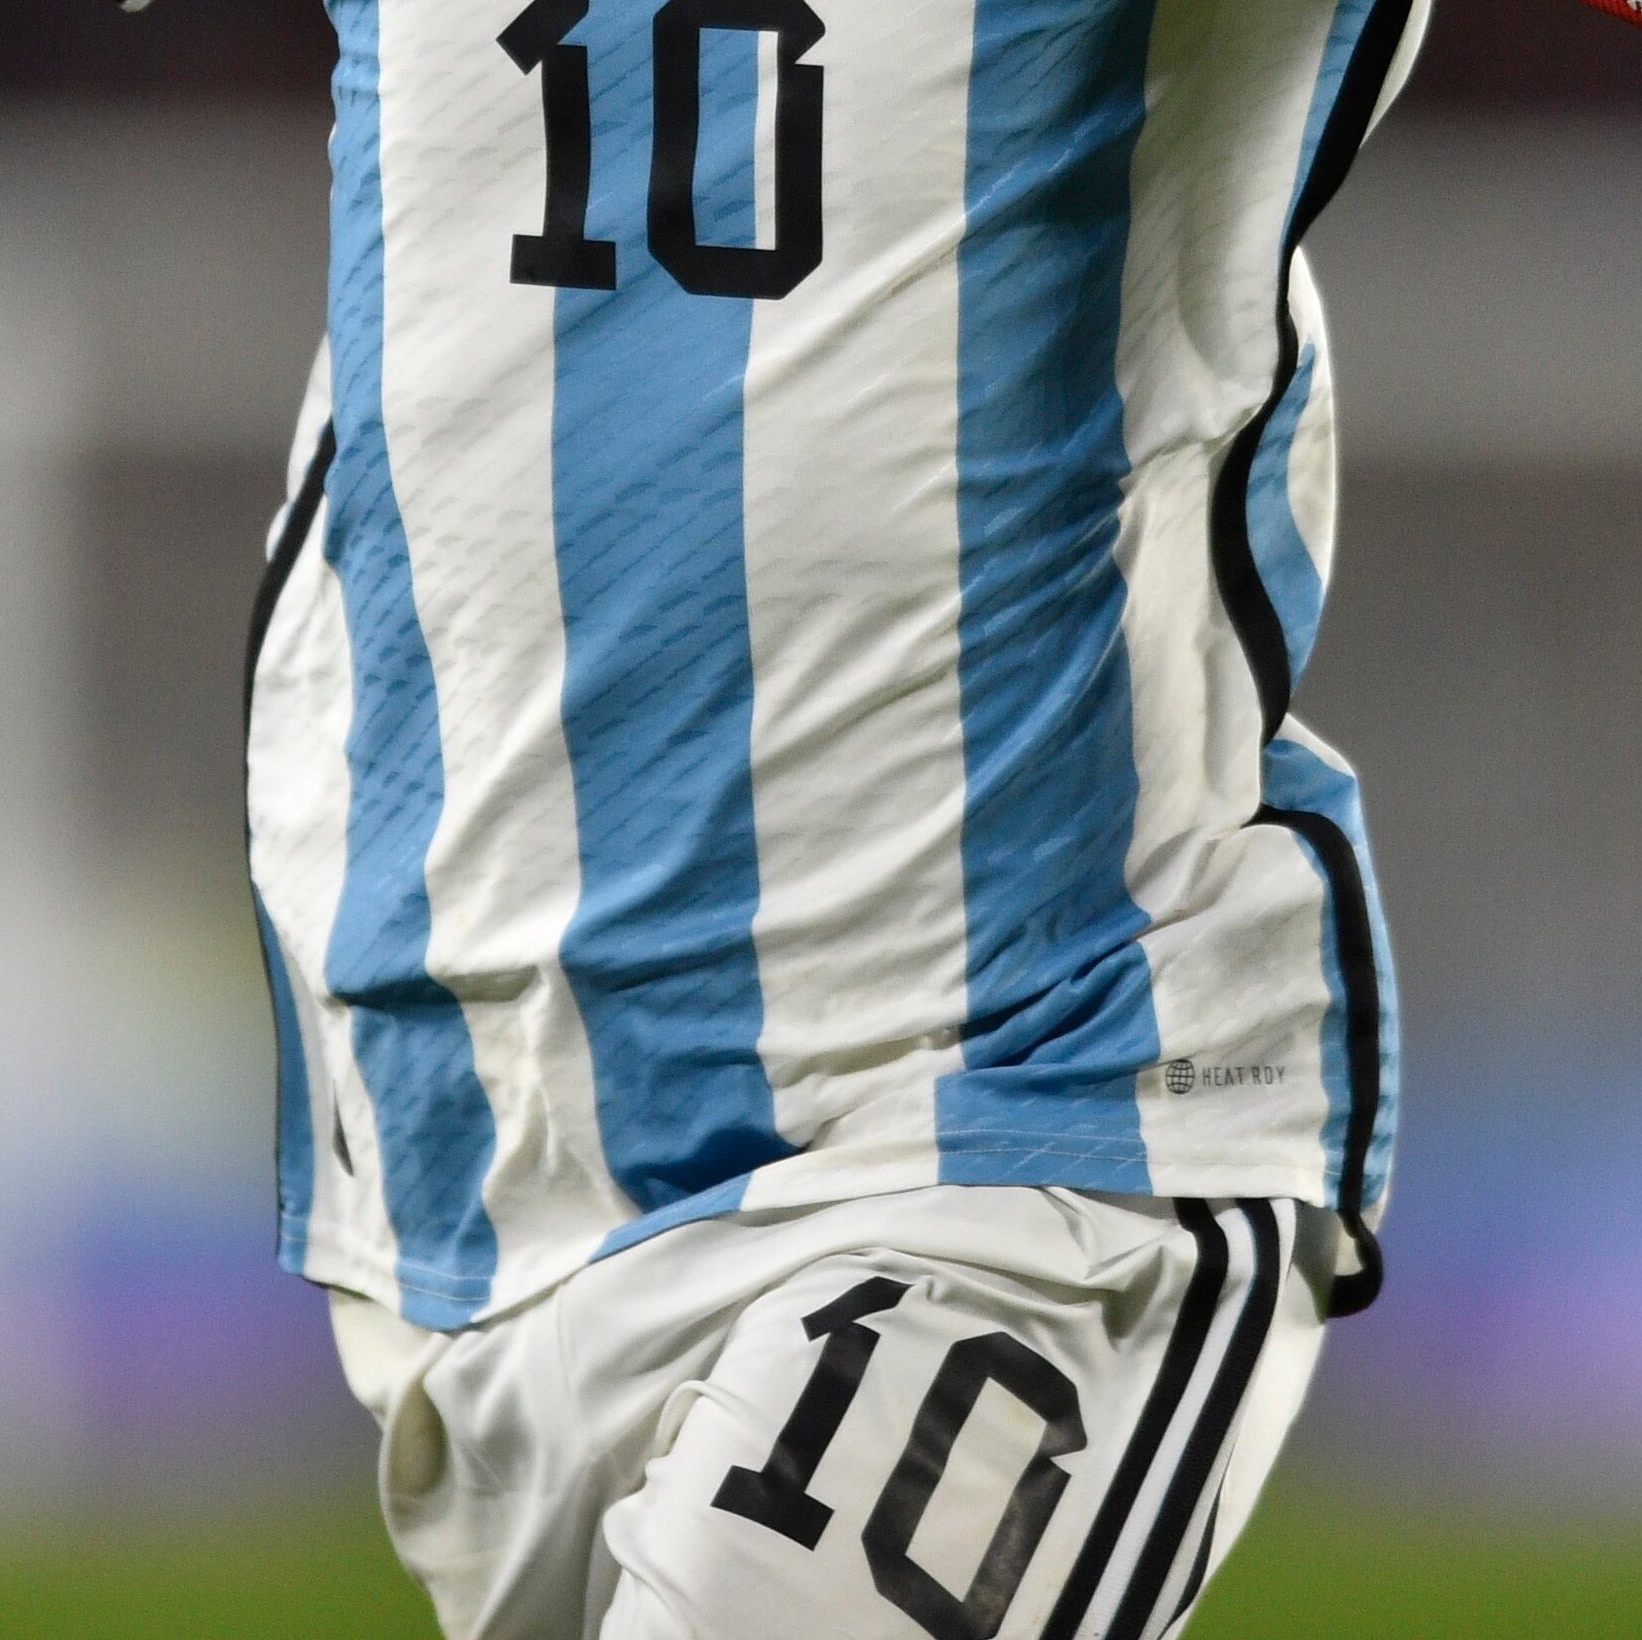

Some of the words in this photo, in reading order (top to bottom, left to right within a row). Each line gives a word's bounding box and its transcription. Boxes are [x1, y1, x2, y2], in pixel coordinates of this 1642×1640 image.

[1202, 1066, 1244, 1087] HEAT
[1251, 1065, 1285, 1085] RDY
[710, 1276, 1087, 1640] 10
